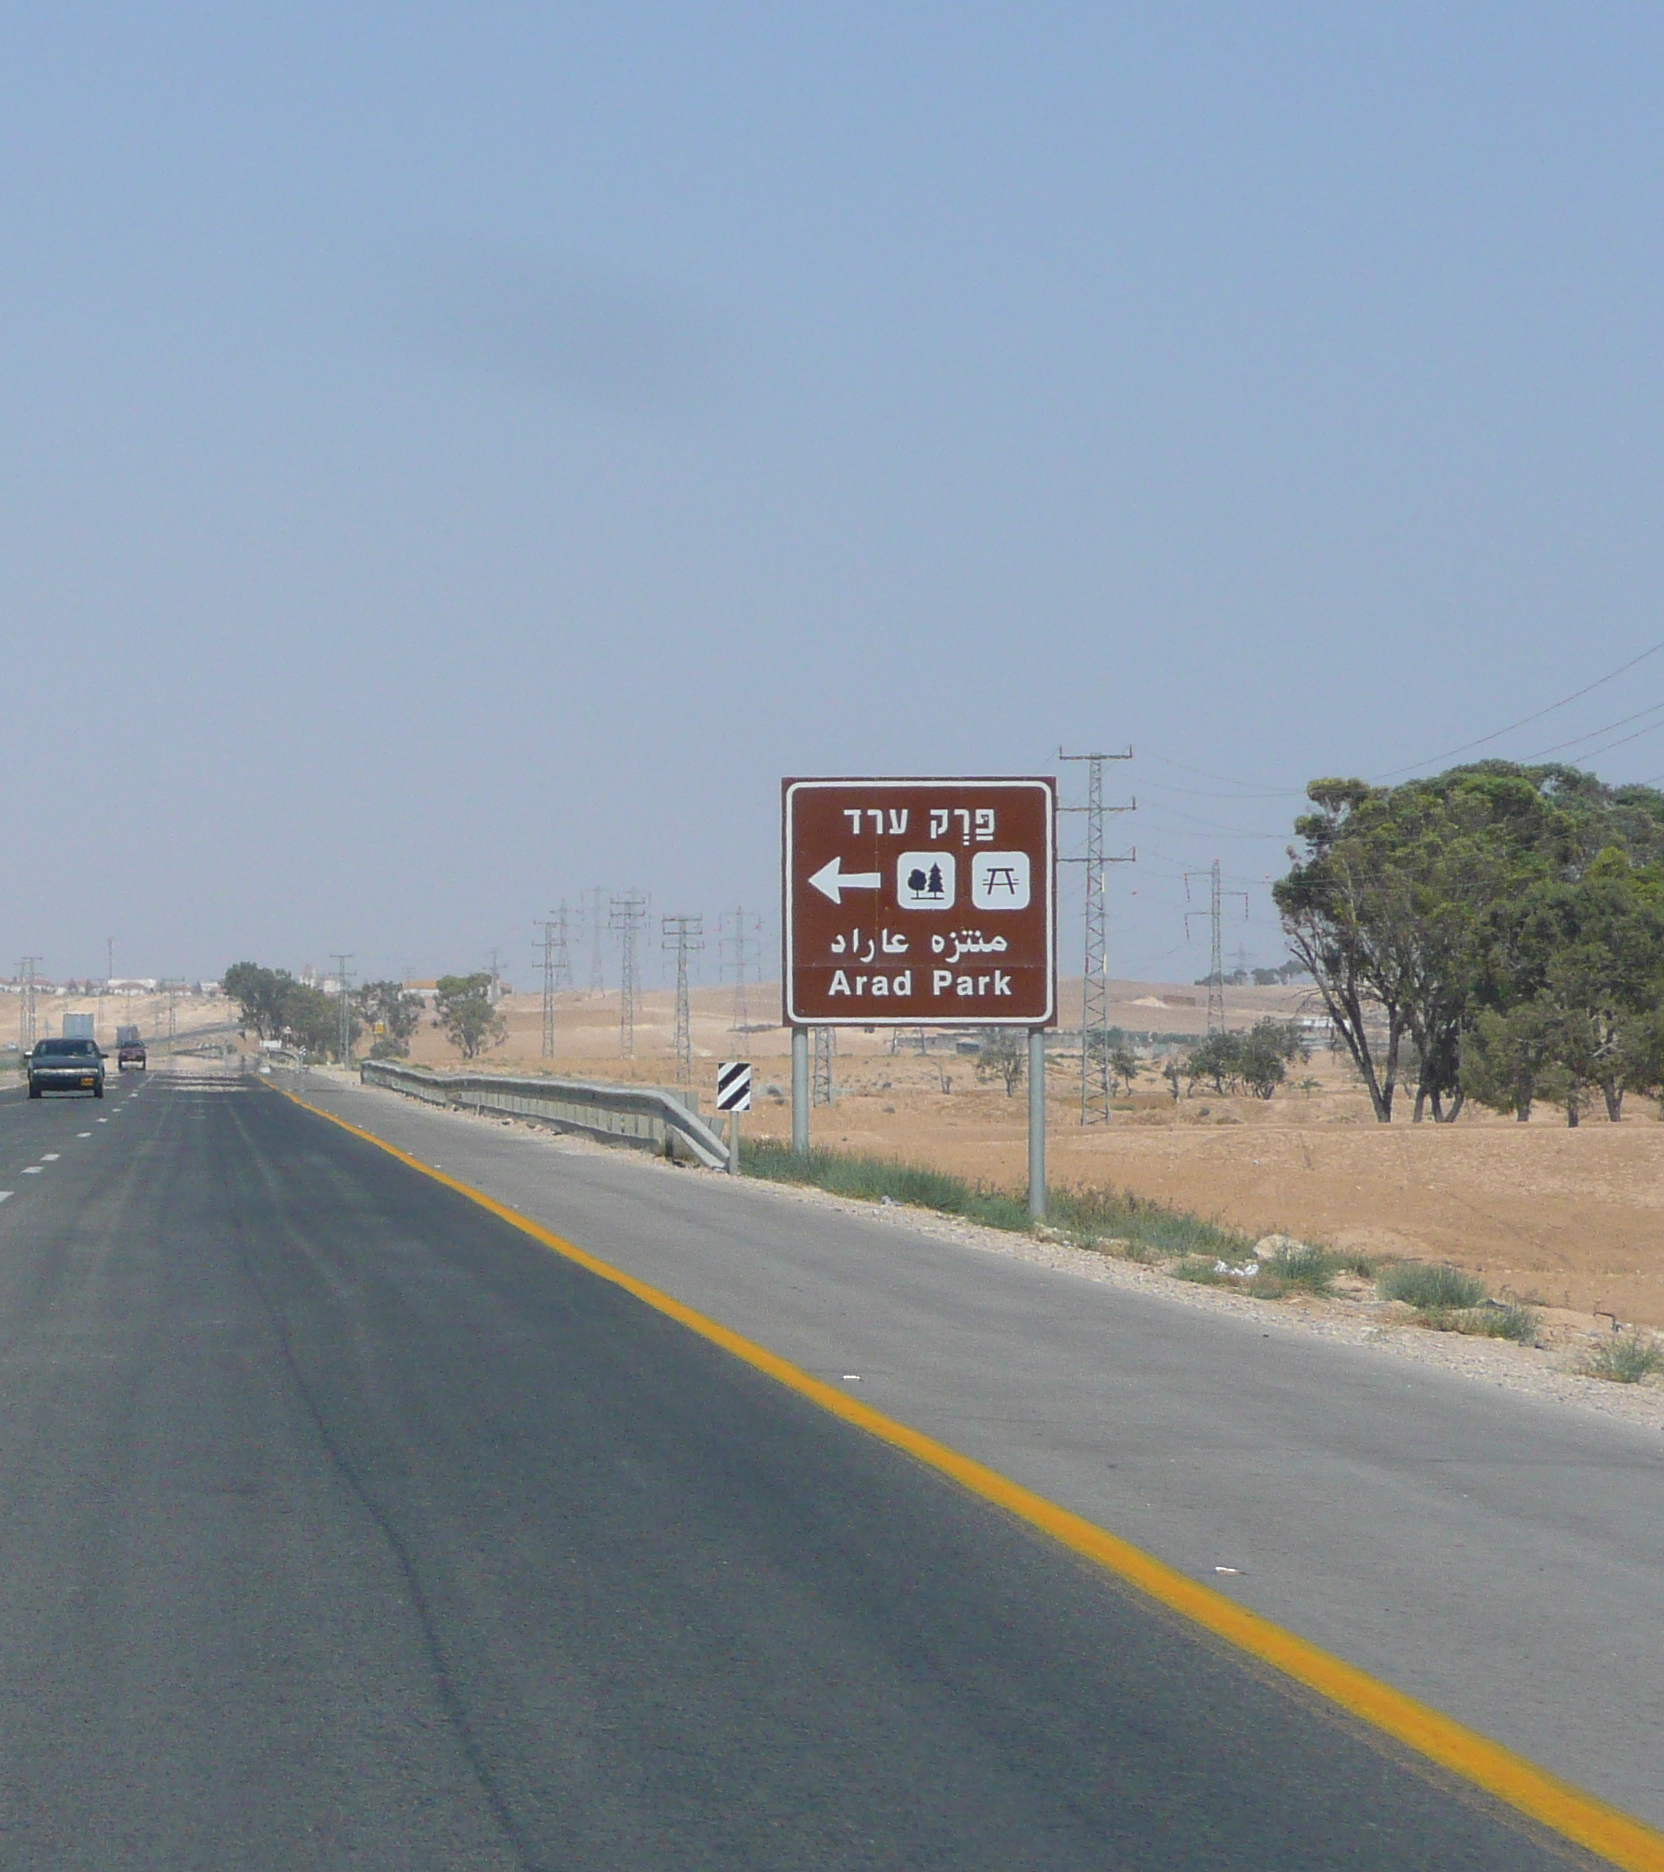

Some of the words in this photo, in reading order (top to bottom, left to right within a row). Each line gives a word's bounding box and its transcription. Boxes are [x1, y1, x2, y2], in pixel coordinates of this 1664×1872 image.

[843, 809, 908, 835] ערד
[831, 928, 909, 963] عاراد
[931, 930, 1008, 963] منتزه
[828, 970, 912, 996] Arad
[933, 970, 1012, 996] Park
